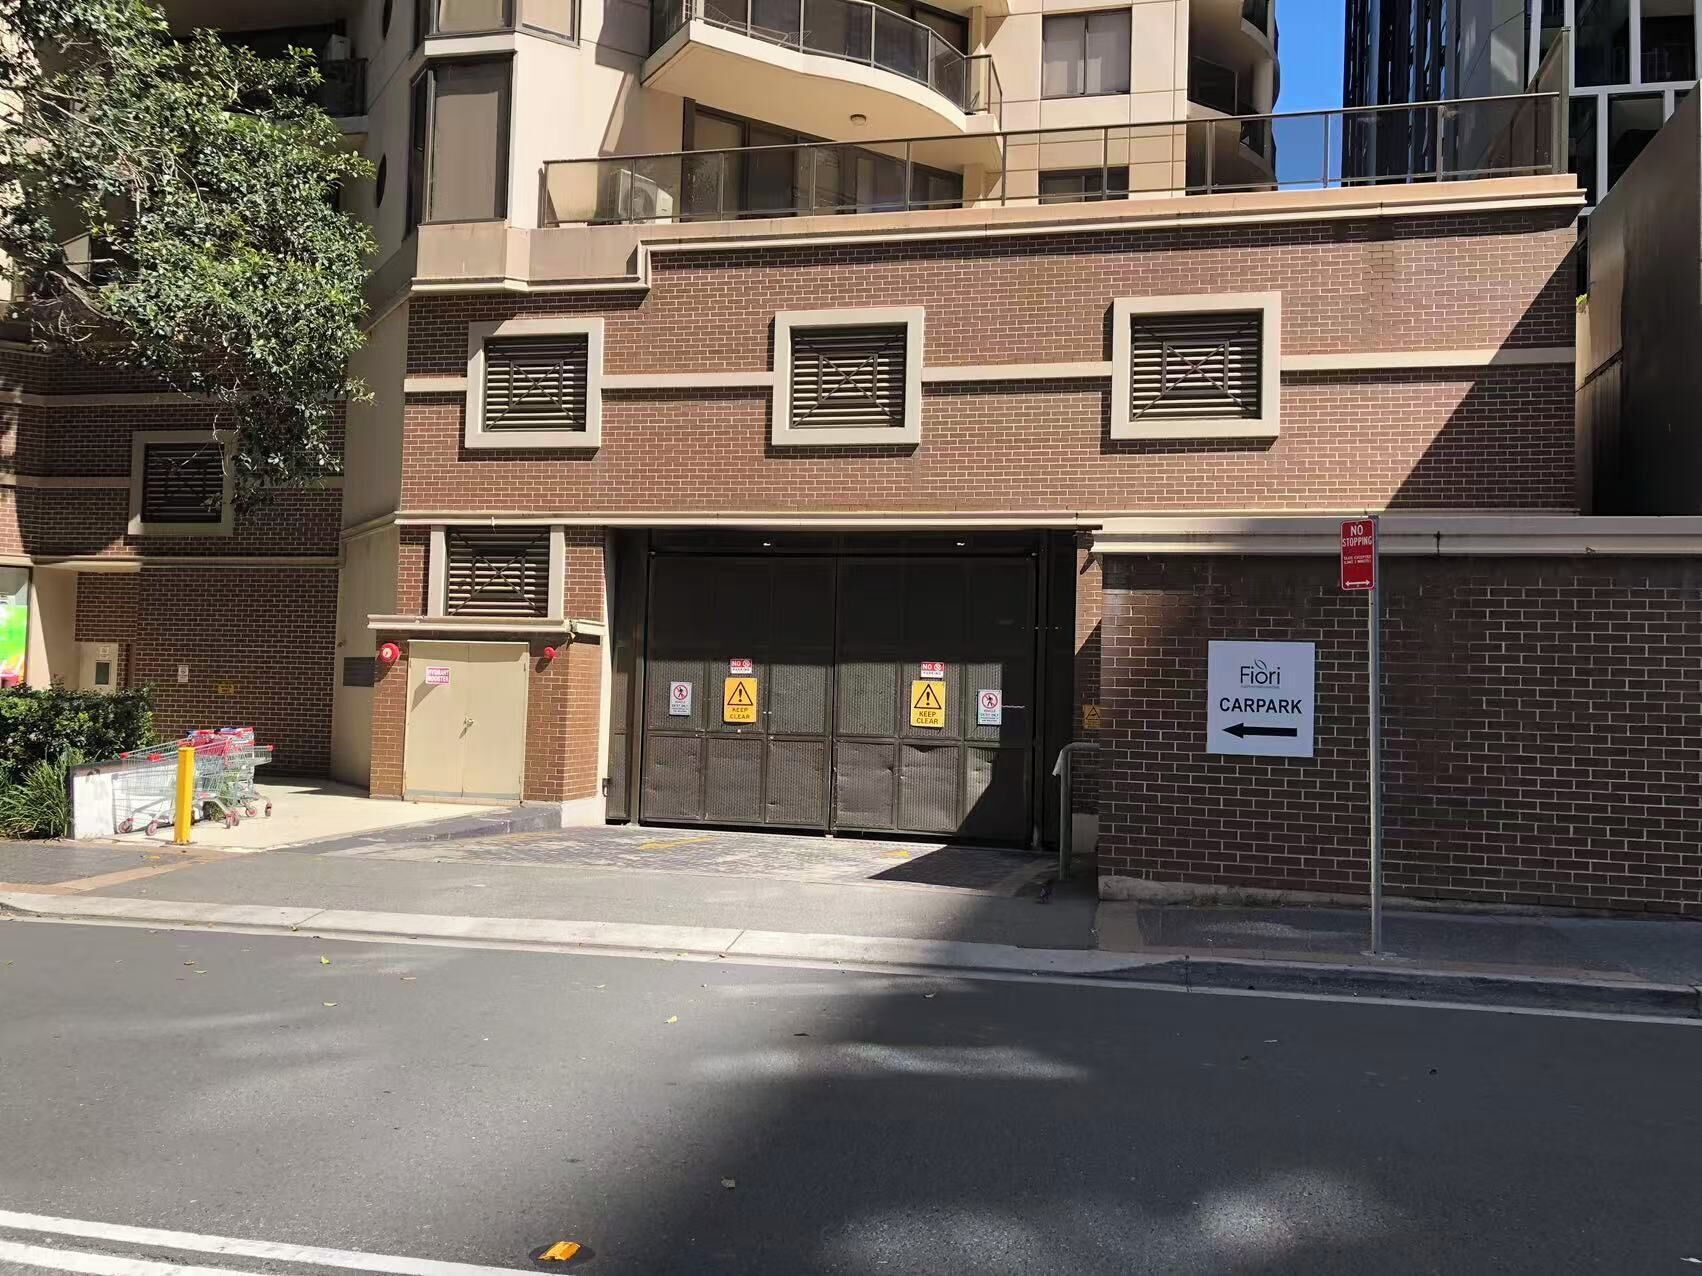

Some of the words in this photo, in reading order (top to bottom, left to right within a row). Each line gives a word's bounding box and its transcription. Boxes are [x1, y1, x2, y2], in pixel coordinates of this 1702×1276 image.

[1351, 525, 1364, 536] NO
[1342, 536, 1373, 547] STOPPING
[1240, 665, 1280, 685] Fiori
[1219, 697, 1303, 714] CARPARK
[916, 717, 939, 725] CLEAR
